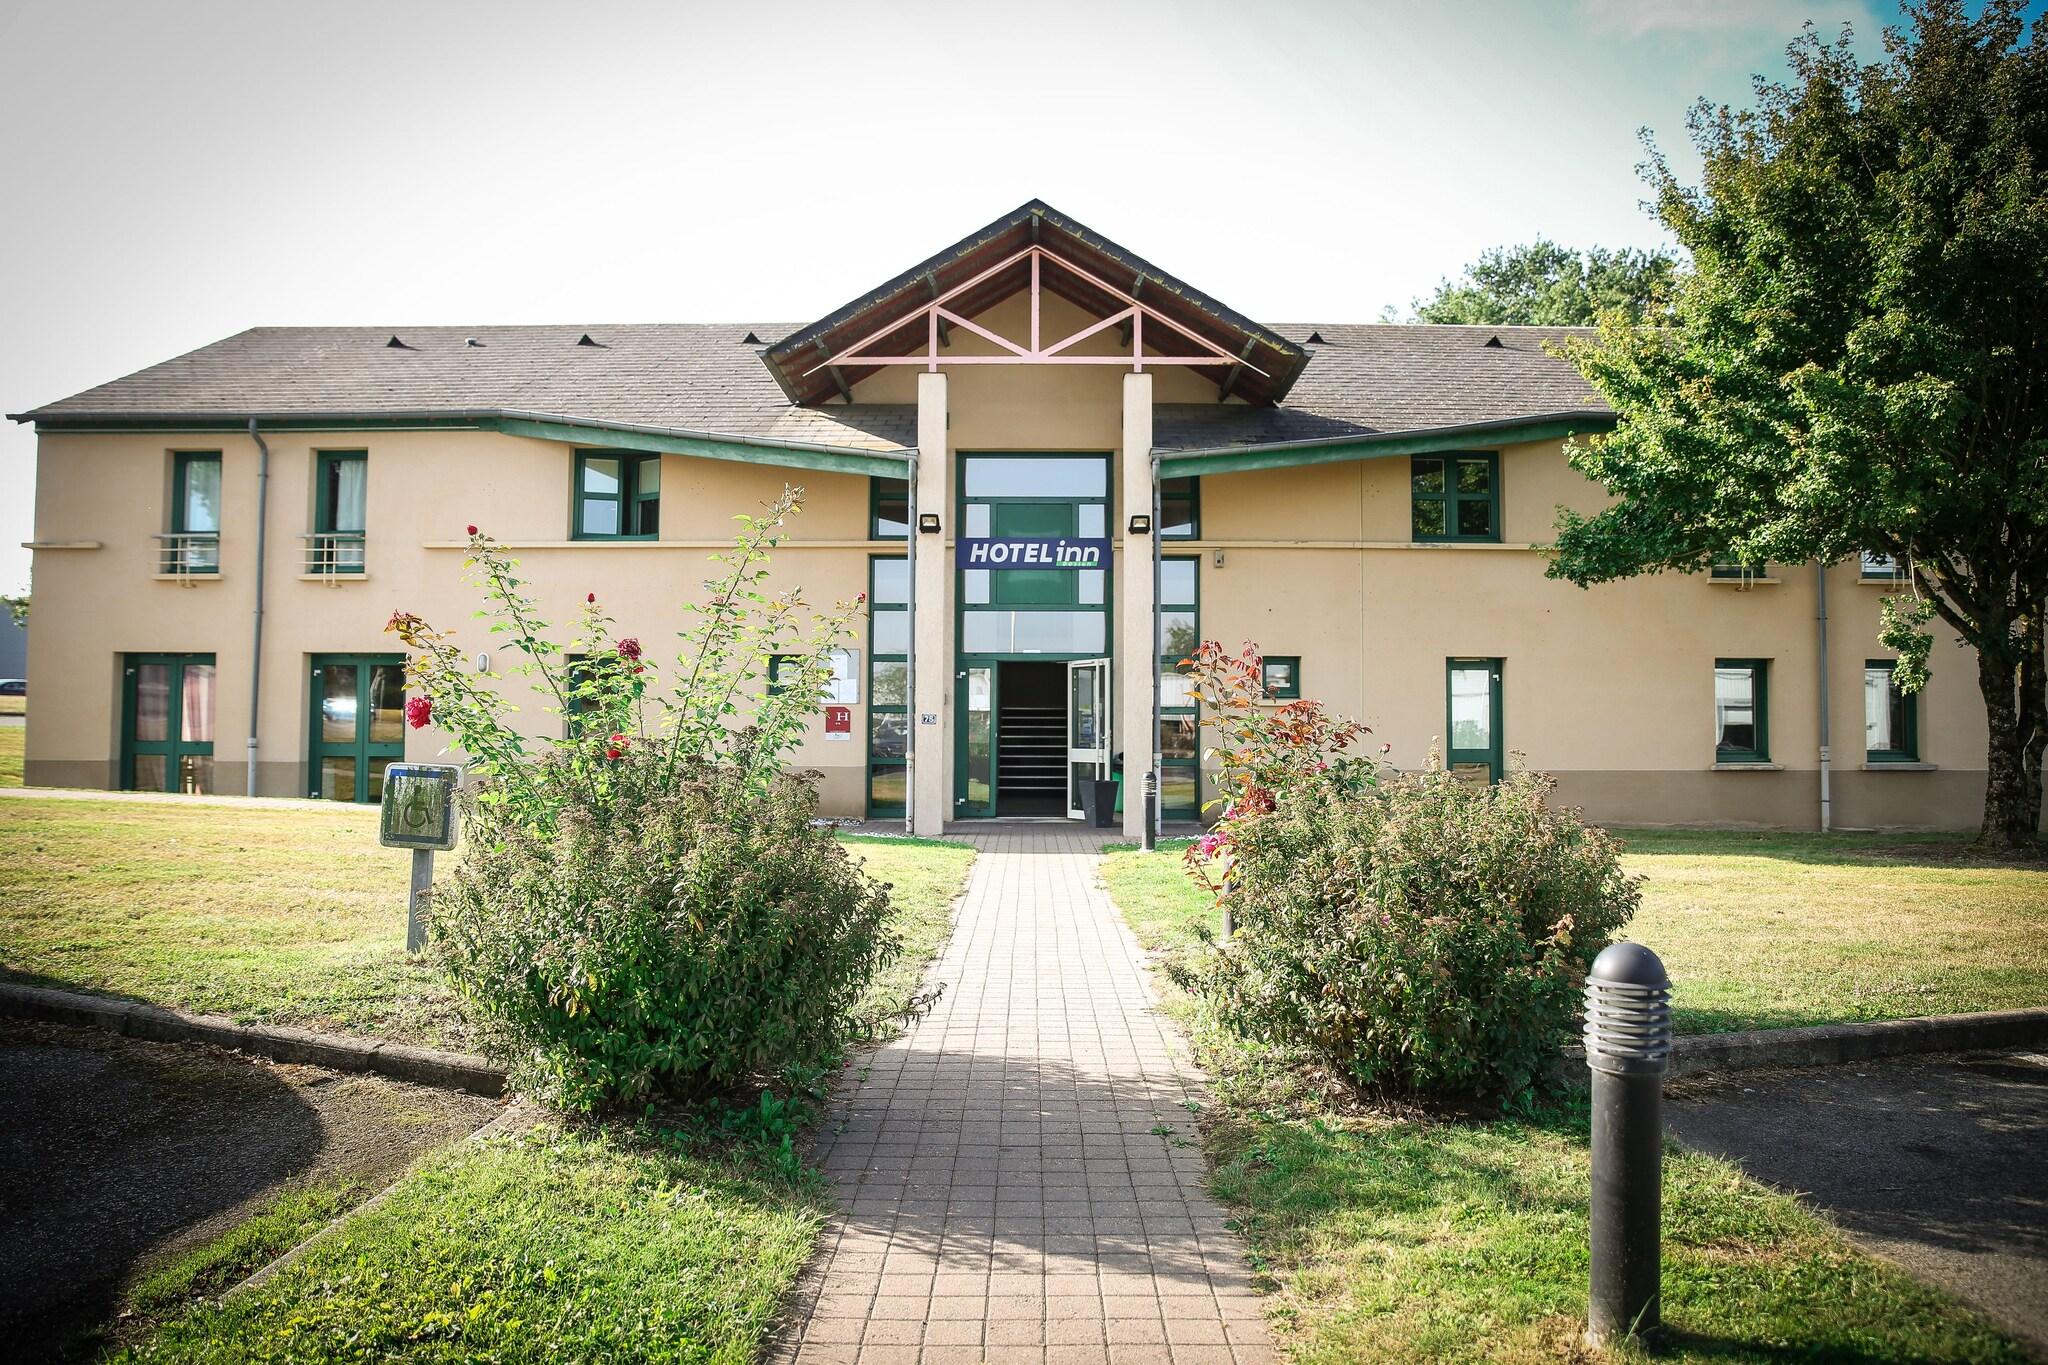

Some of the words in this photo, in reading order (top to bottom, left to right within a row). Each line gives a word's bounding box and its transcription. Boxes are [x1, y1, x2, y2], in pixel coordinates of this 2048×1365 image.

[969, 543, 1053, 563] HOTEL
[1056, 540, 1100, 562] inn
[836, 712, 849, 721] H
